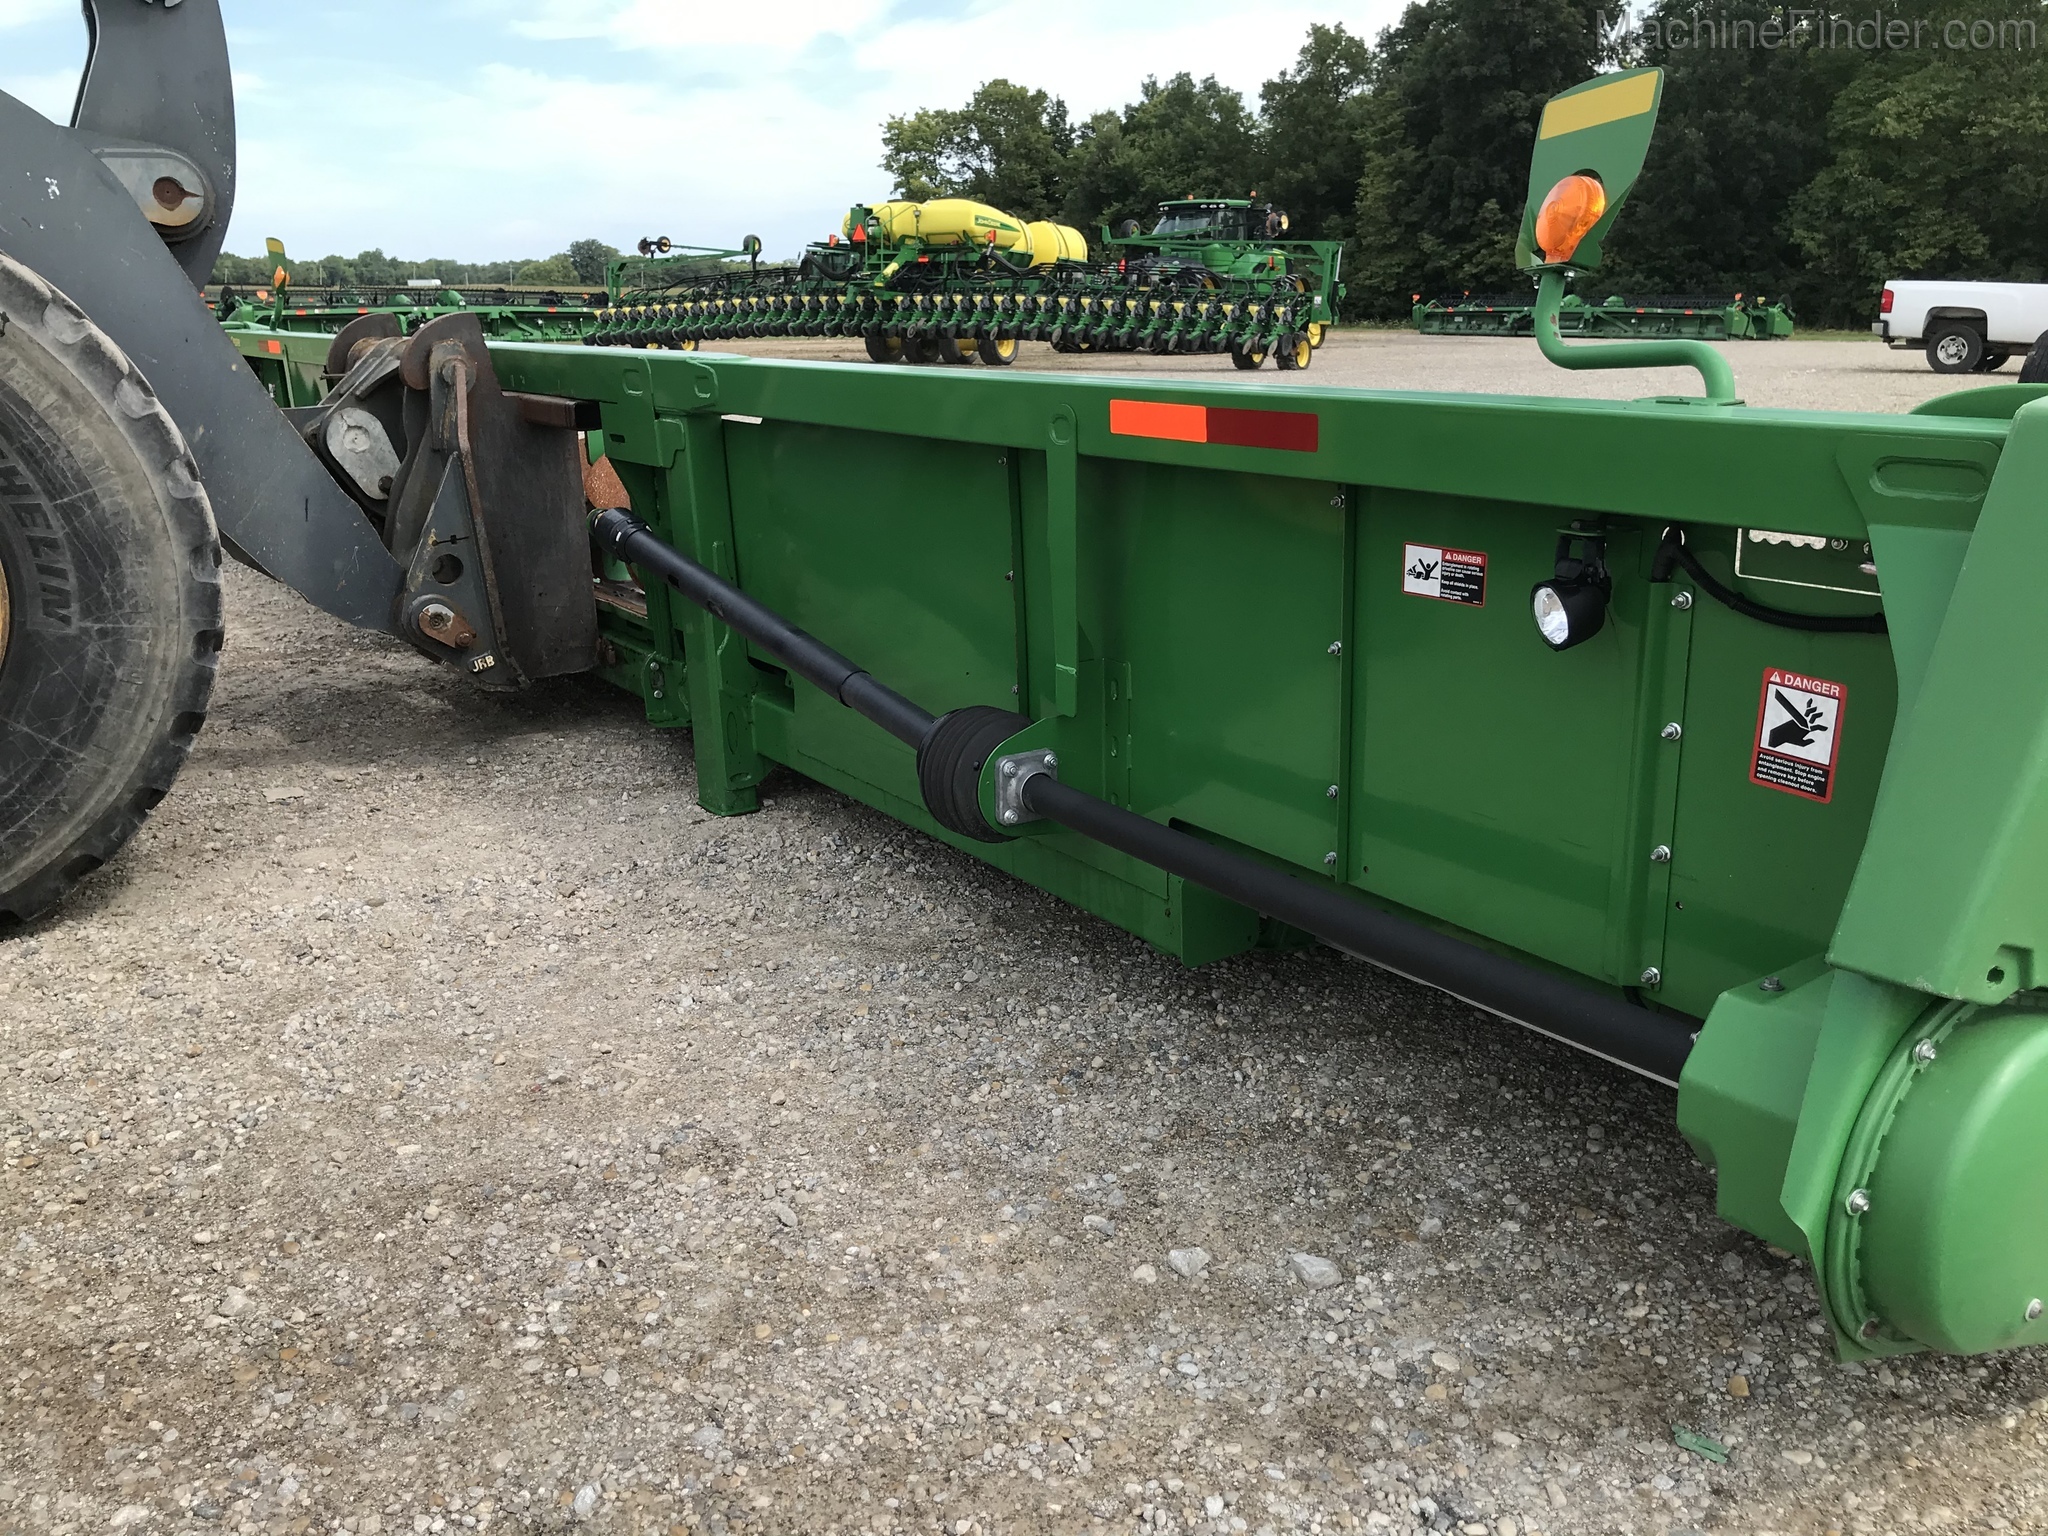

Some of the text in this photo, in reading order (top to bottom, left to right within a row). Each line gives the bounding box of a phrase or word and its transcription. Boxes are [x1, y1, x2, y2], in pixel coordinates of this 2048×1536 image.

[1453, 554, 1482, 564] DANGER
[472, 655, 495, 672] JRB
[1784, 674, 1840, 696] DANGER
[1775, 758, 1794, 767] serious
[1795, 763, 1809, 771] injury
[1756, 773, 1777, 782] opening
[1777, 779, 1799, 788] cleanout
[1768, 769, 1786, 778] remove
[1797, 777, 1814, 785] before
[1808, 773, 1825, 782] engine
